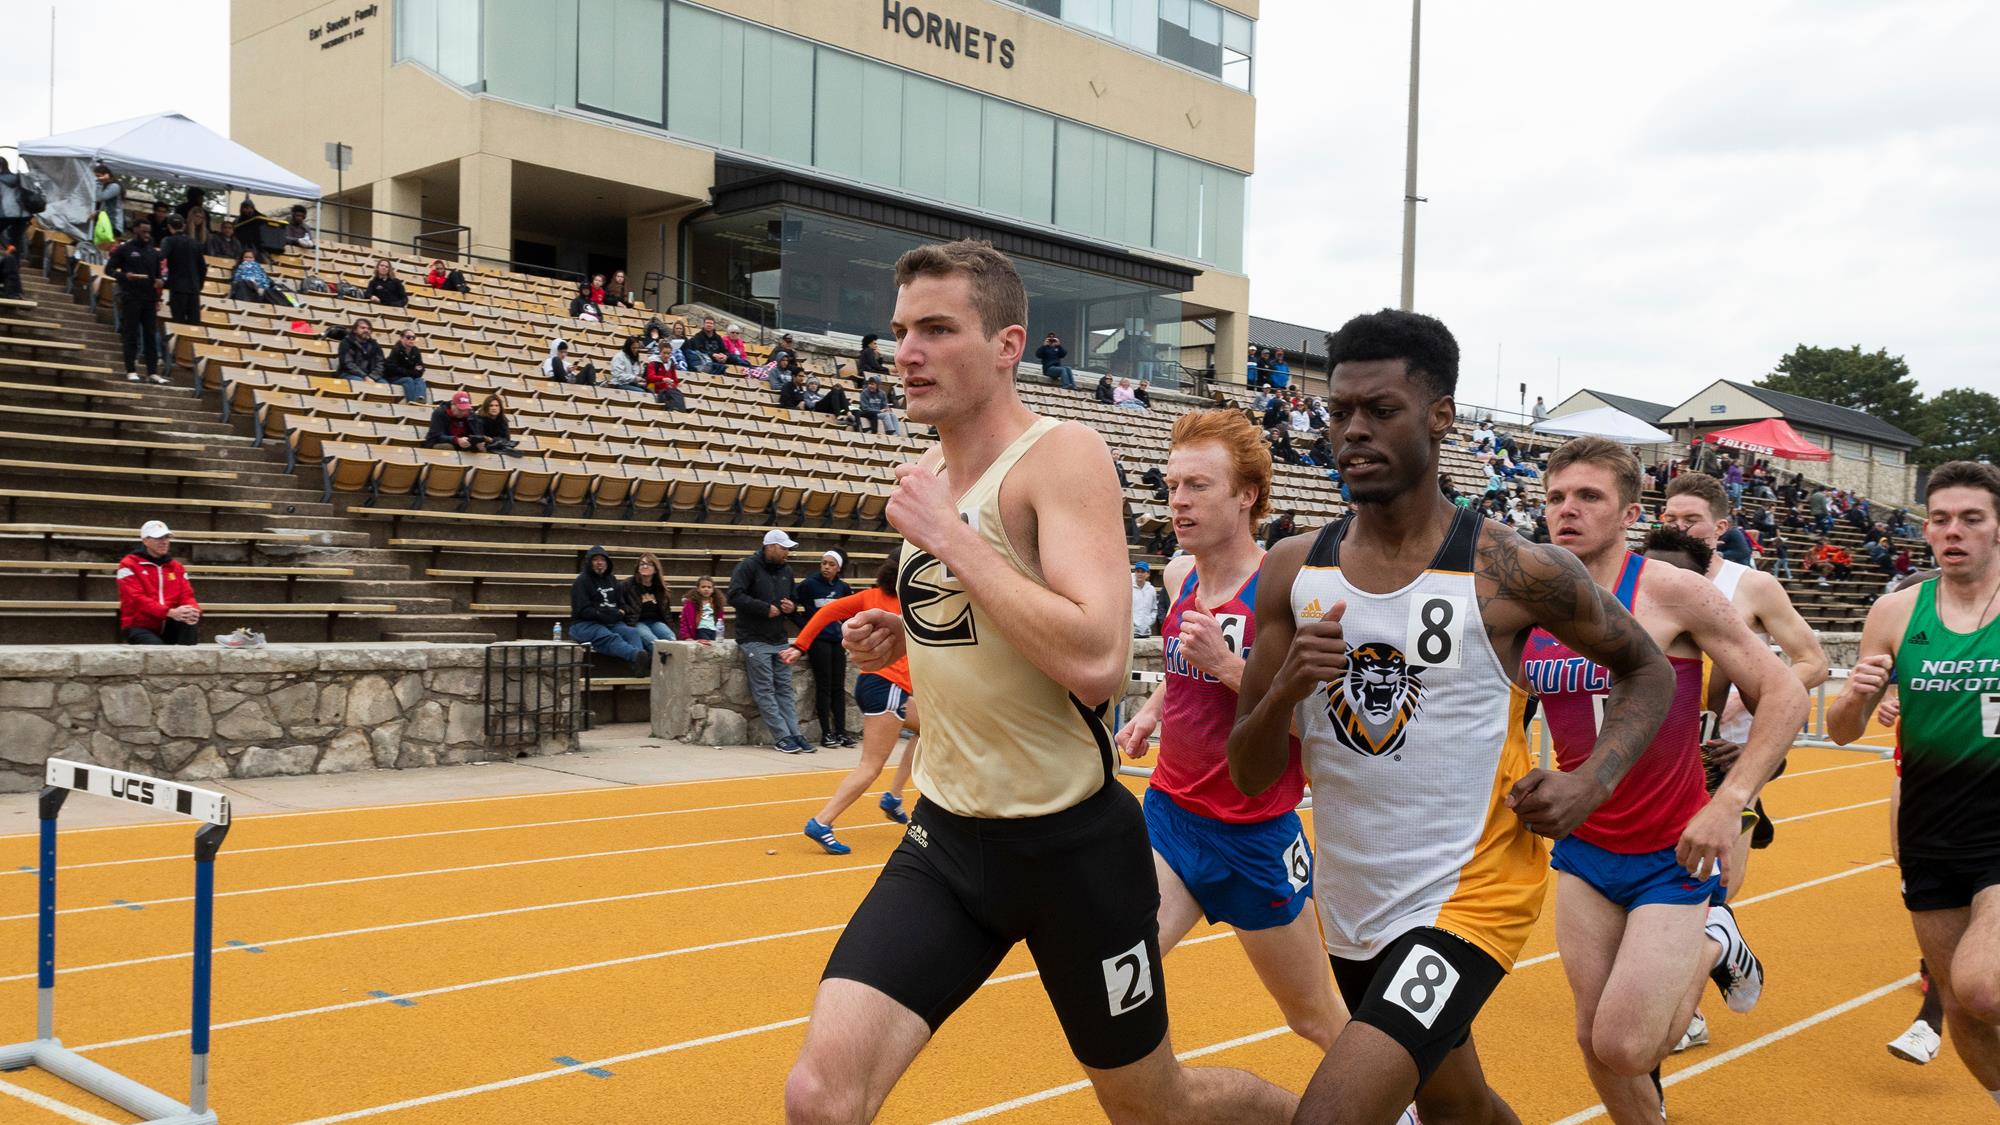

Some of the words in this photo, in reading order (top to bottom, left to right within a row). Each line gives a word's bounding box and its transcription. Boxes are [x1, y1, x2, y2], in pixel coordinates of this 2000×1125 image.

[882, 0, 1015, 69] HORNETS
[1717, 436, 1774, 455] FALCONS
[1417, 598, 1454, 664] 8
[1909, 677, 2000, 692] DAKOT
[111, 775, 155, 805] UCS
[907, 828, 929, 848] adidas
[1291, 840, 1309, 883] 6
[1114, 953, 1147, 1010] 2
[1400, 954, 1448, 1014] 8
